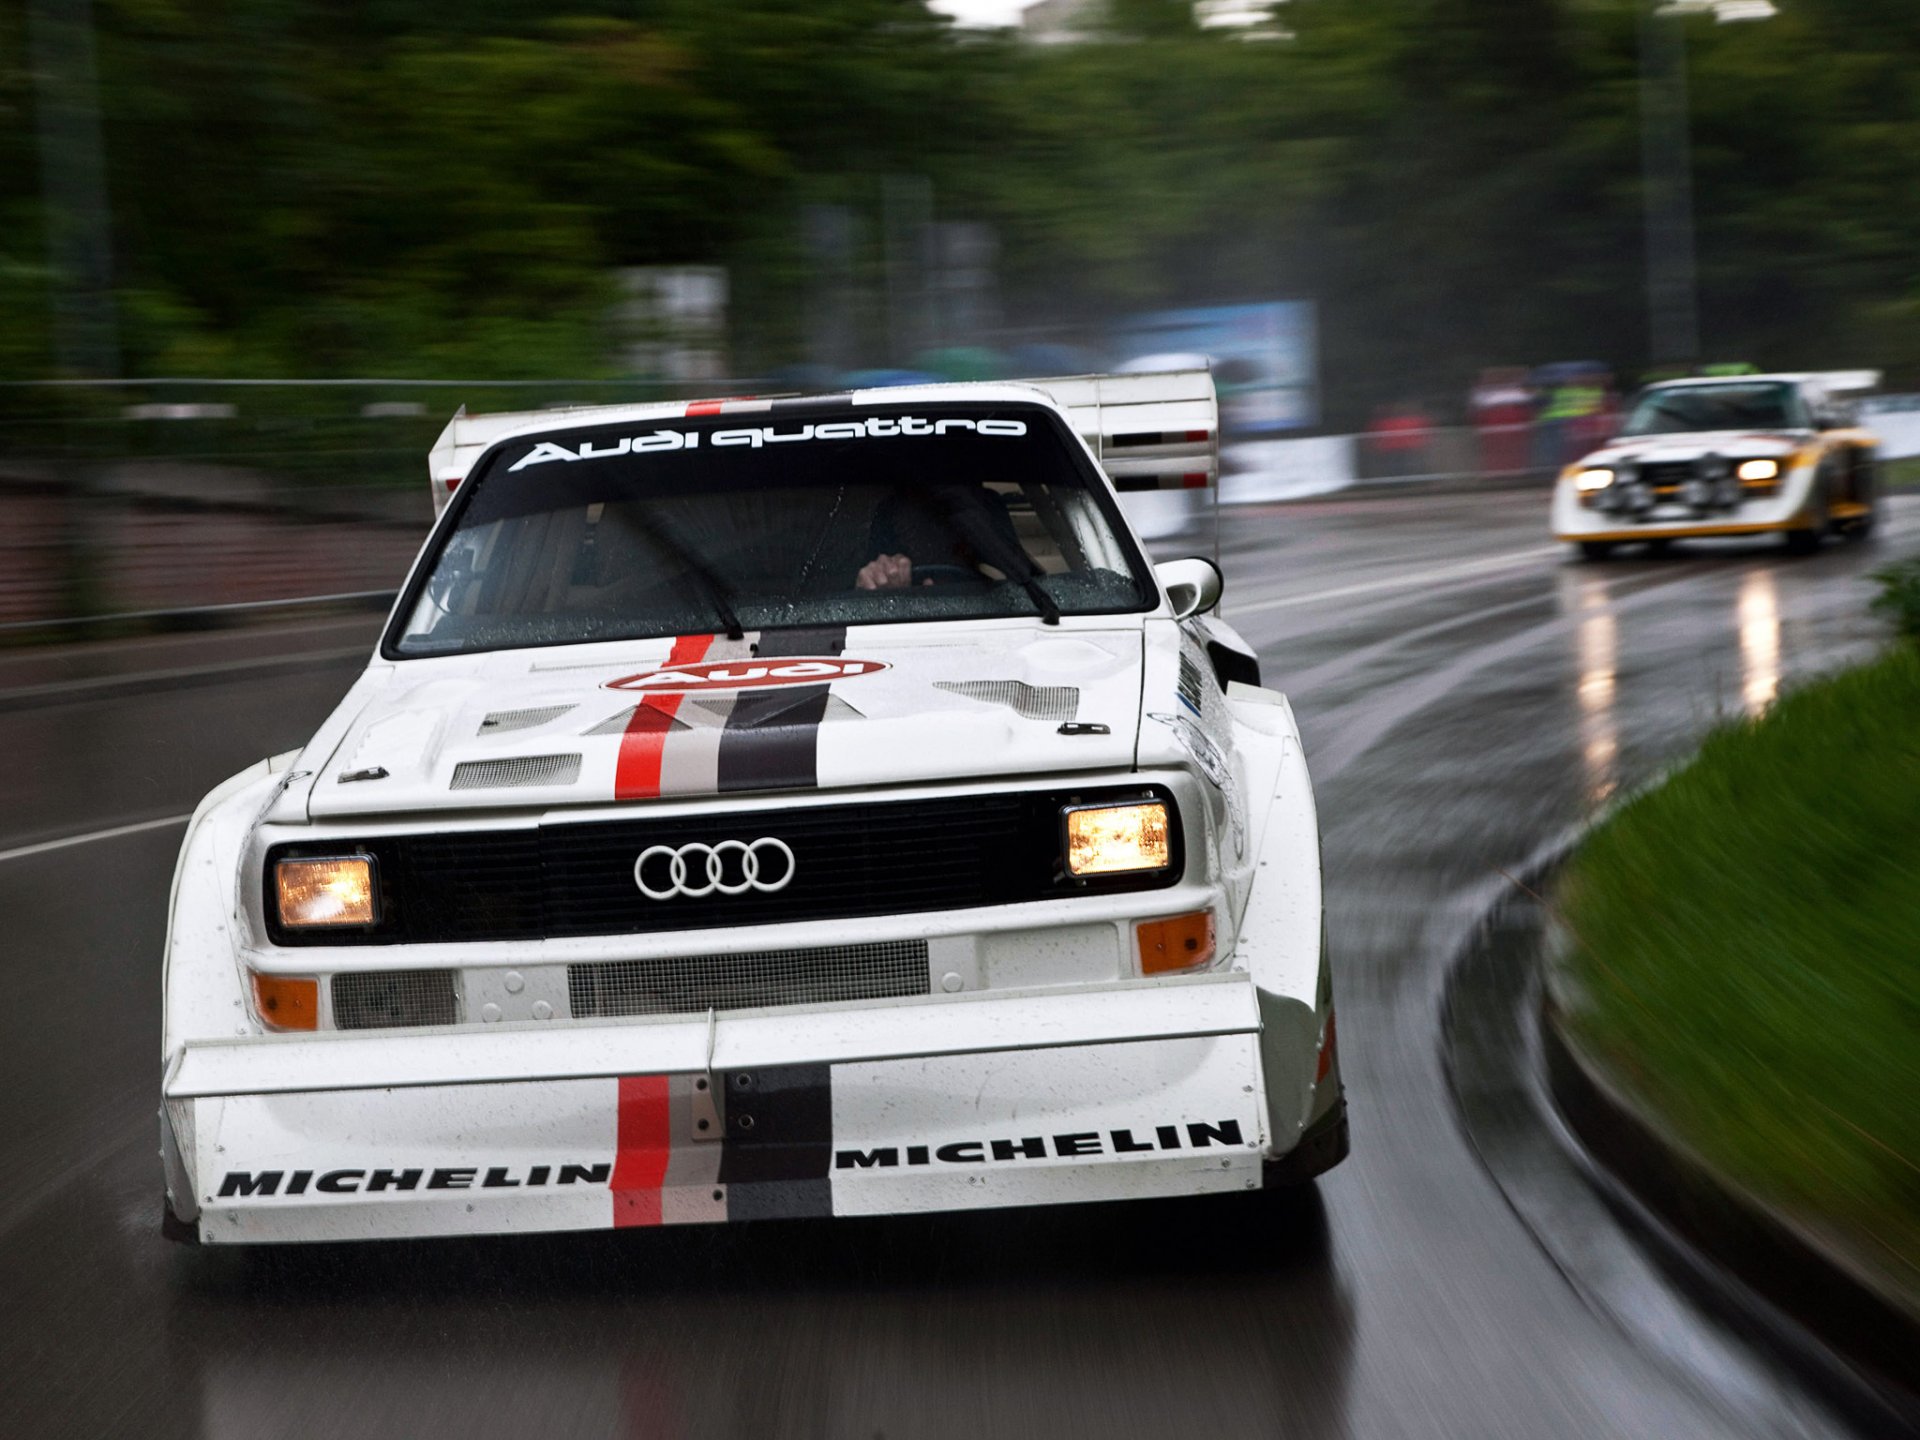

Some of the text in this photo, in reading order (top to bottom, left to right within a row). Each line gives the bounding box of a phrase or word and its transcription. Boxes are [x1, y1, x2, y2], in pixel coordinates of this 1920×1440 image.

[508, 416, 1028, 472] Audi quattro
[618, 662, 865, 688] Audi
[835, 1119, 1245, 1169] MICHELIN
[217, 1162, 612, 1198] MICHELIN
